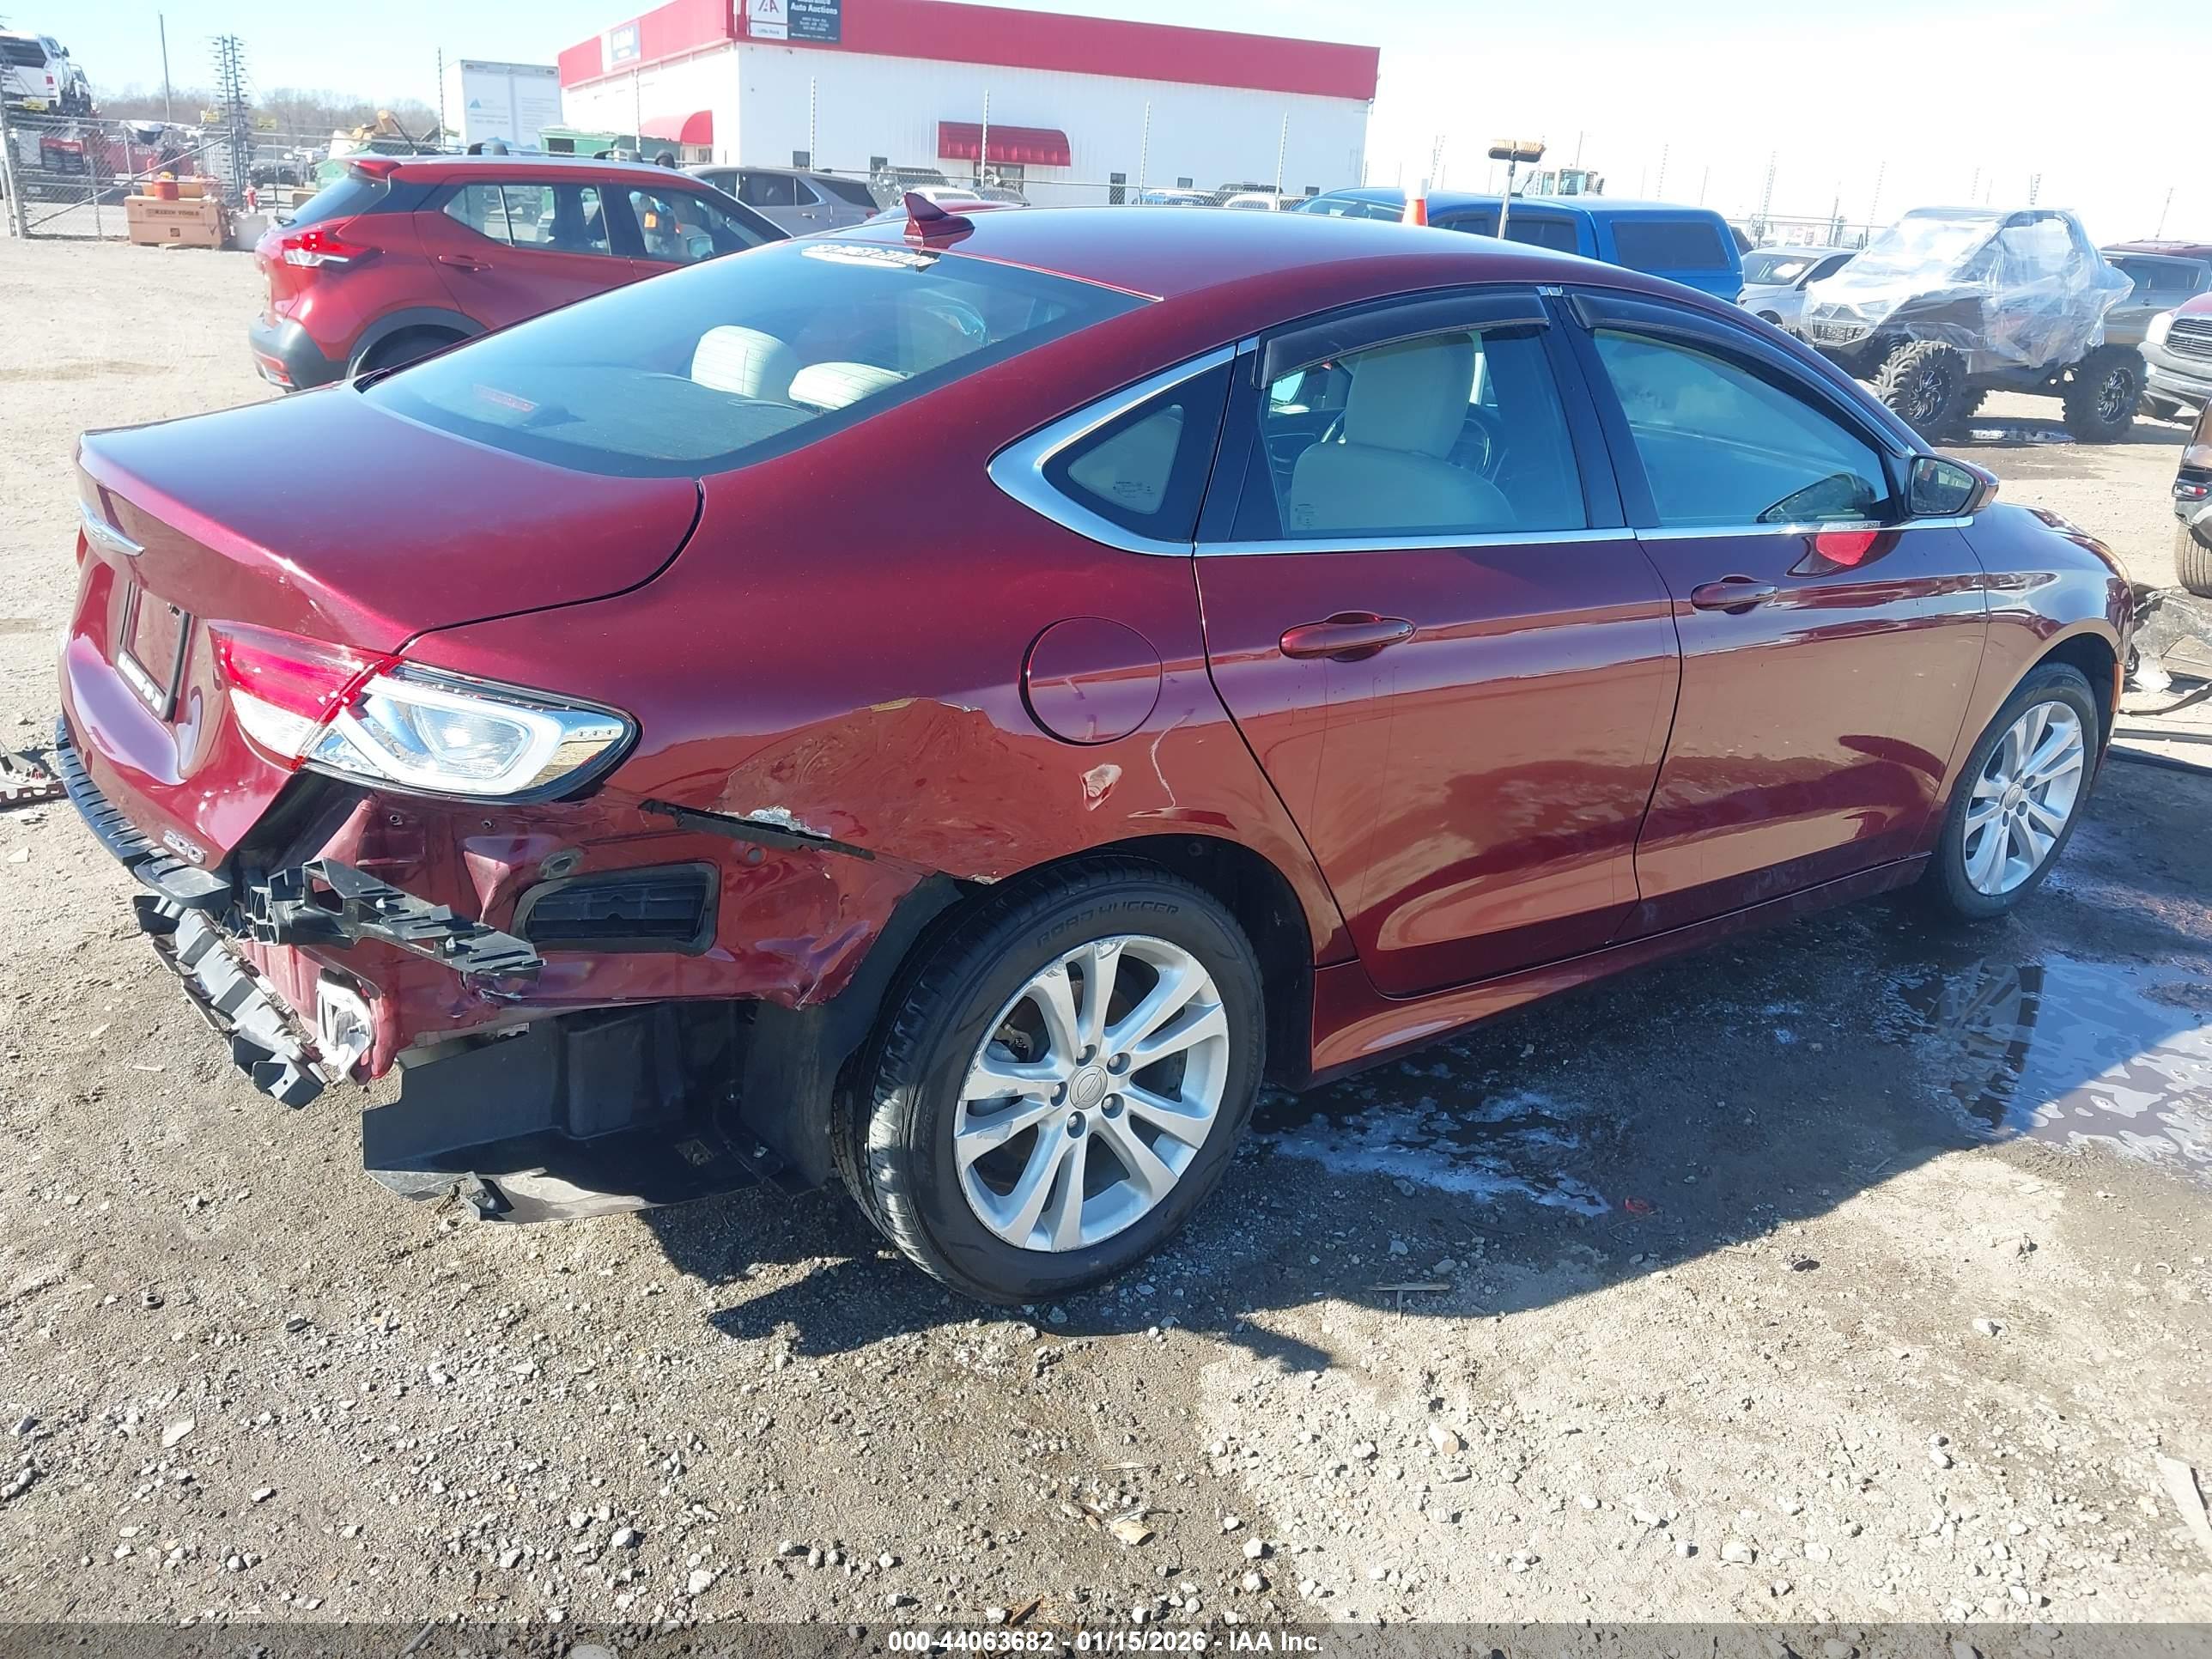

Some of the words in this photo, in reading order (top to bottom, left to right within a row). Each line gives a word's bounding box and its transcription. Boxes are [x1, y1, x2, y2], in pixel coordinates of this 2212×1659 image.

[790, 2, 806, 12] Auto
[807, 4, 838, 15] Auctions
[163, 830, 204, 864] 200
[1037, 909, 1093, 947] ROAD
[1099, 901, 1179, 915] HUGGER
